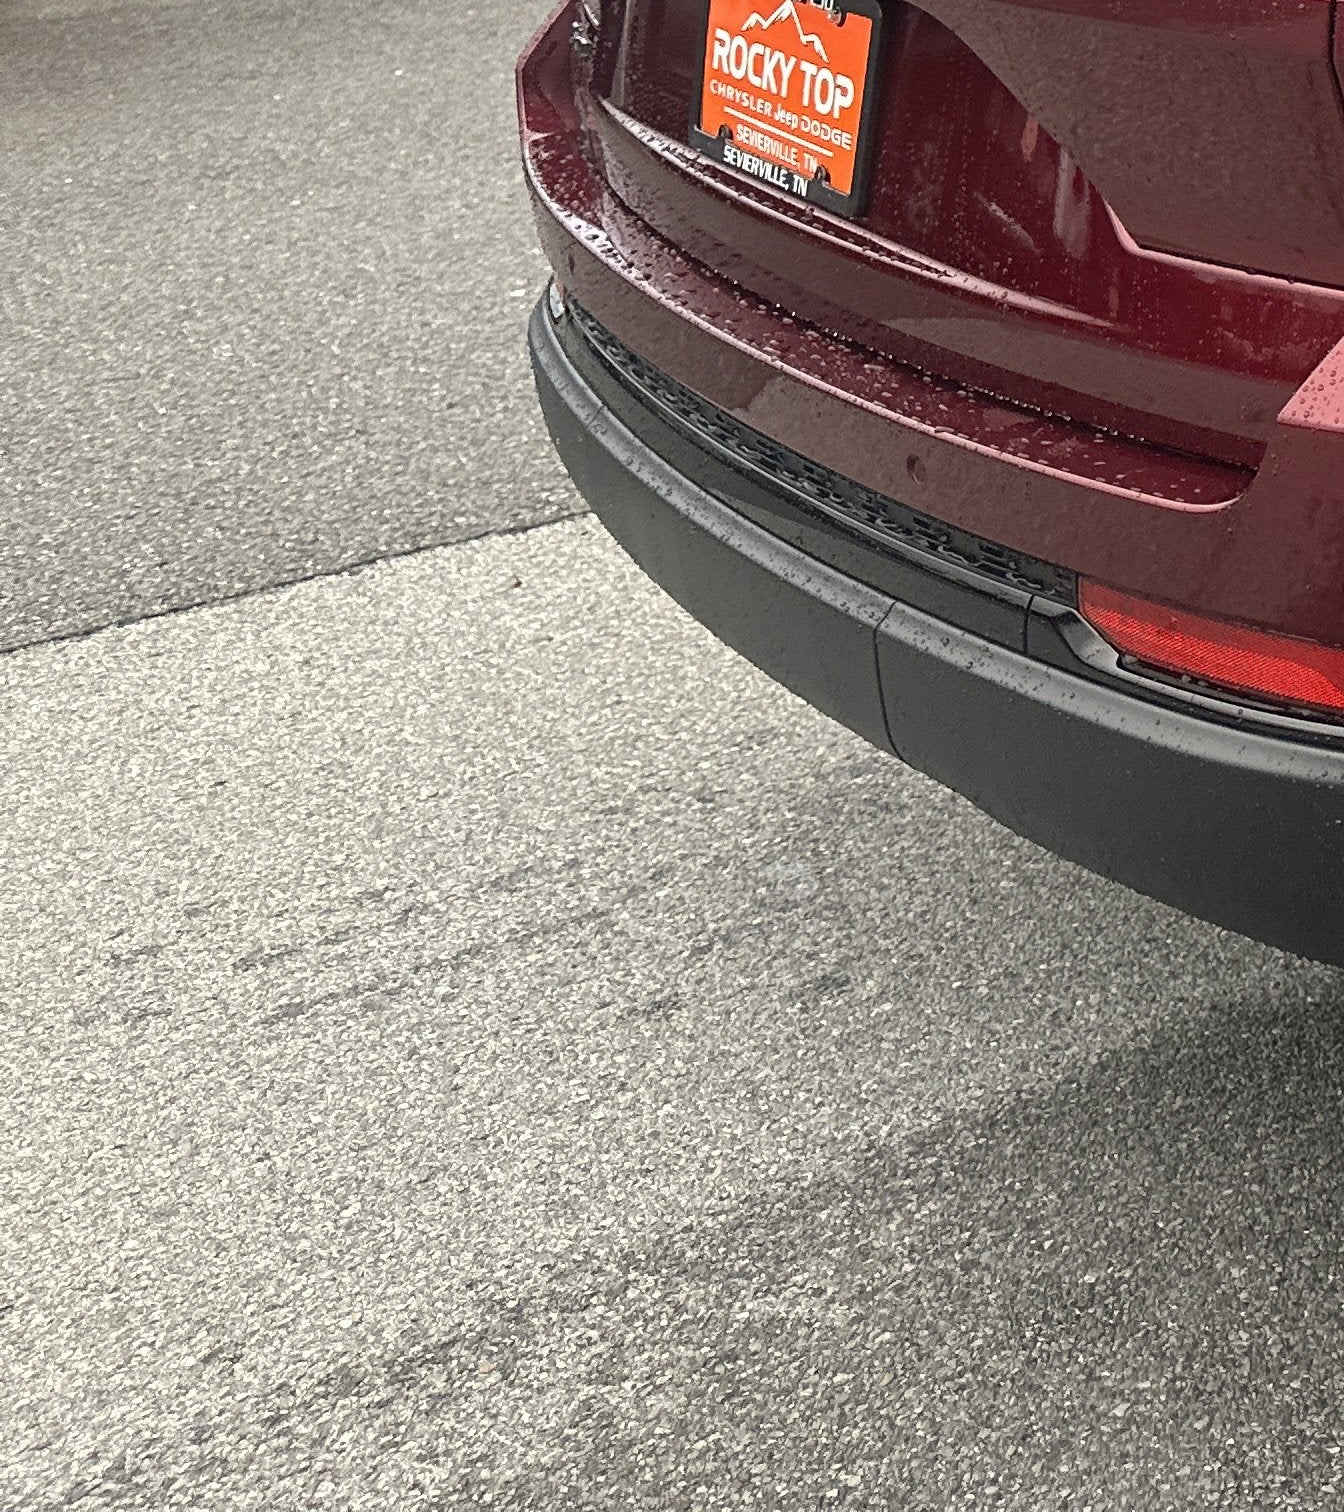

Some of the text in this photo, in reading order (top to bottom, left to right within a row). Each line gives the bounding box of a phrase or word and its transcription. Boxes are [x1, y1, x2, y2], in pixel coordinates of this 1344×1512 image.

[712, 28, 855, 119] ROCKY TOP
[710, 79, 853, 151] CHRYSLER Jeep DODGE
[723, 144, 809, 197] SEVIERVILLE, TN
[803, 152, 818, 174] TN
